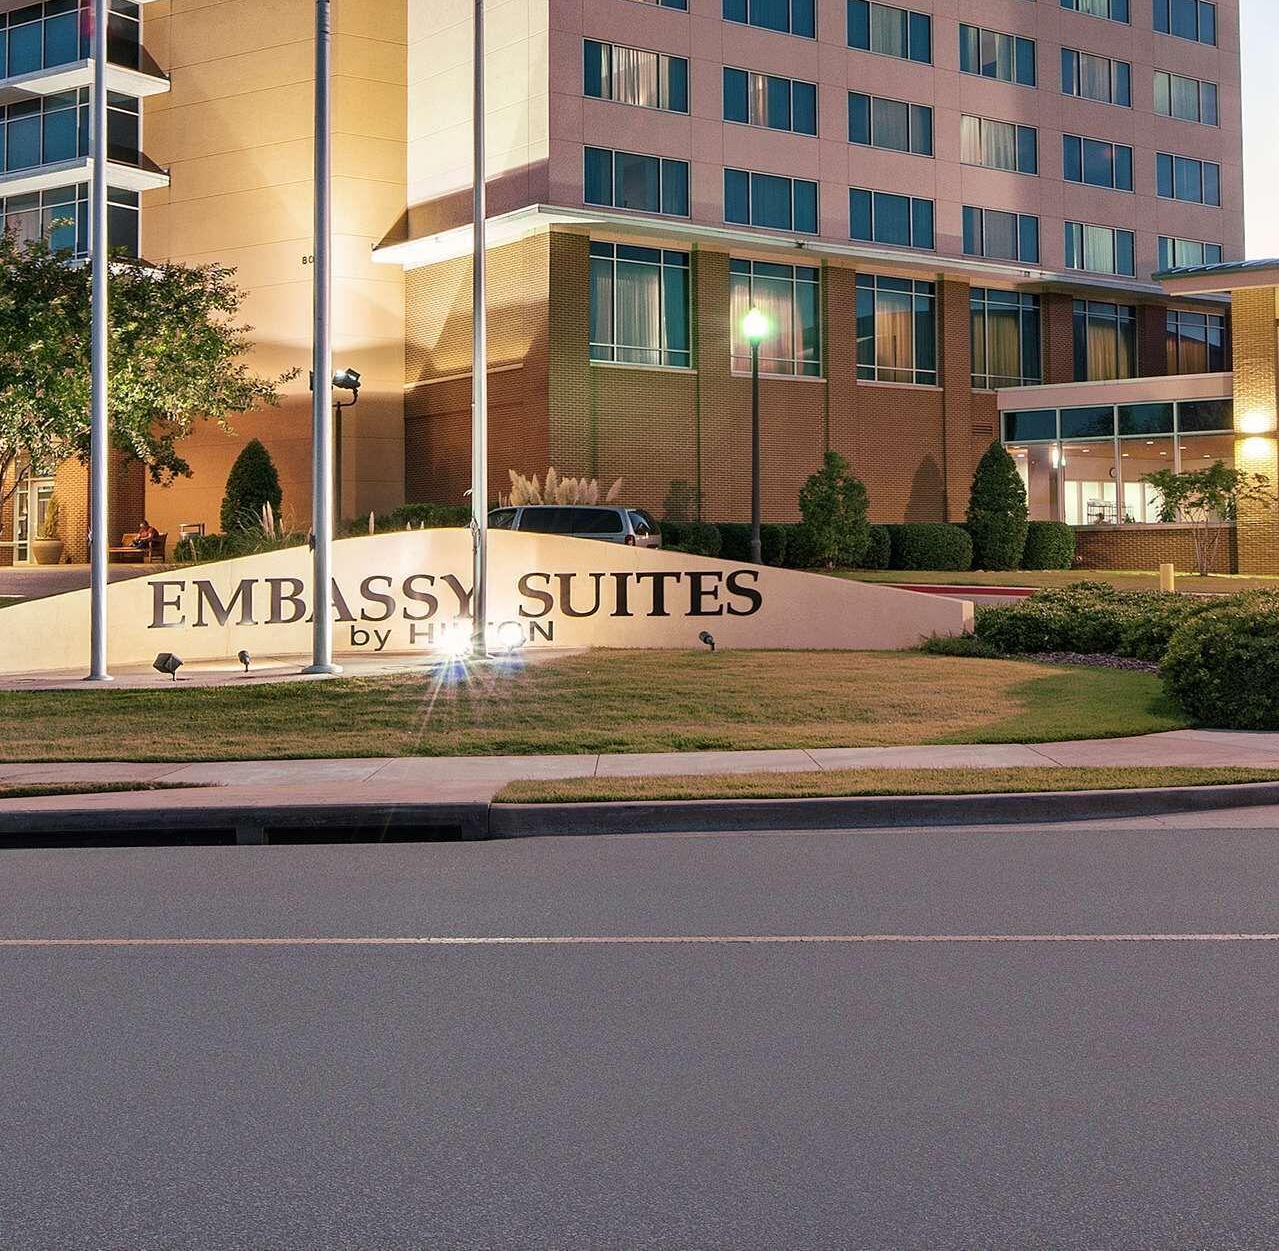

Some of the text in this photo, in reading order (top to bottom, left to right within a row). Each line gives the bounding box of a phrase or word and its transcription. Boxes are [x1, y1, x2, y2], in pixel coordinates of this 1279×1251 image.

[147, 569, 763, 629] EMBASSY SUITES
[350, 620, 554, 652] by HON
